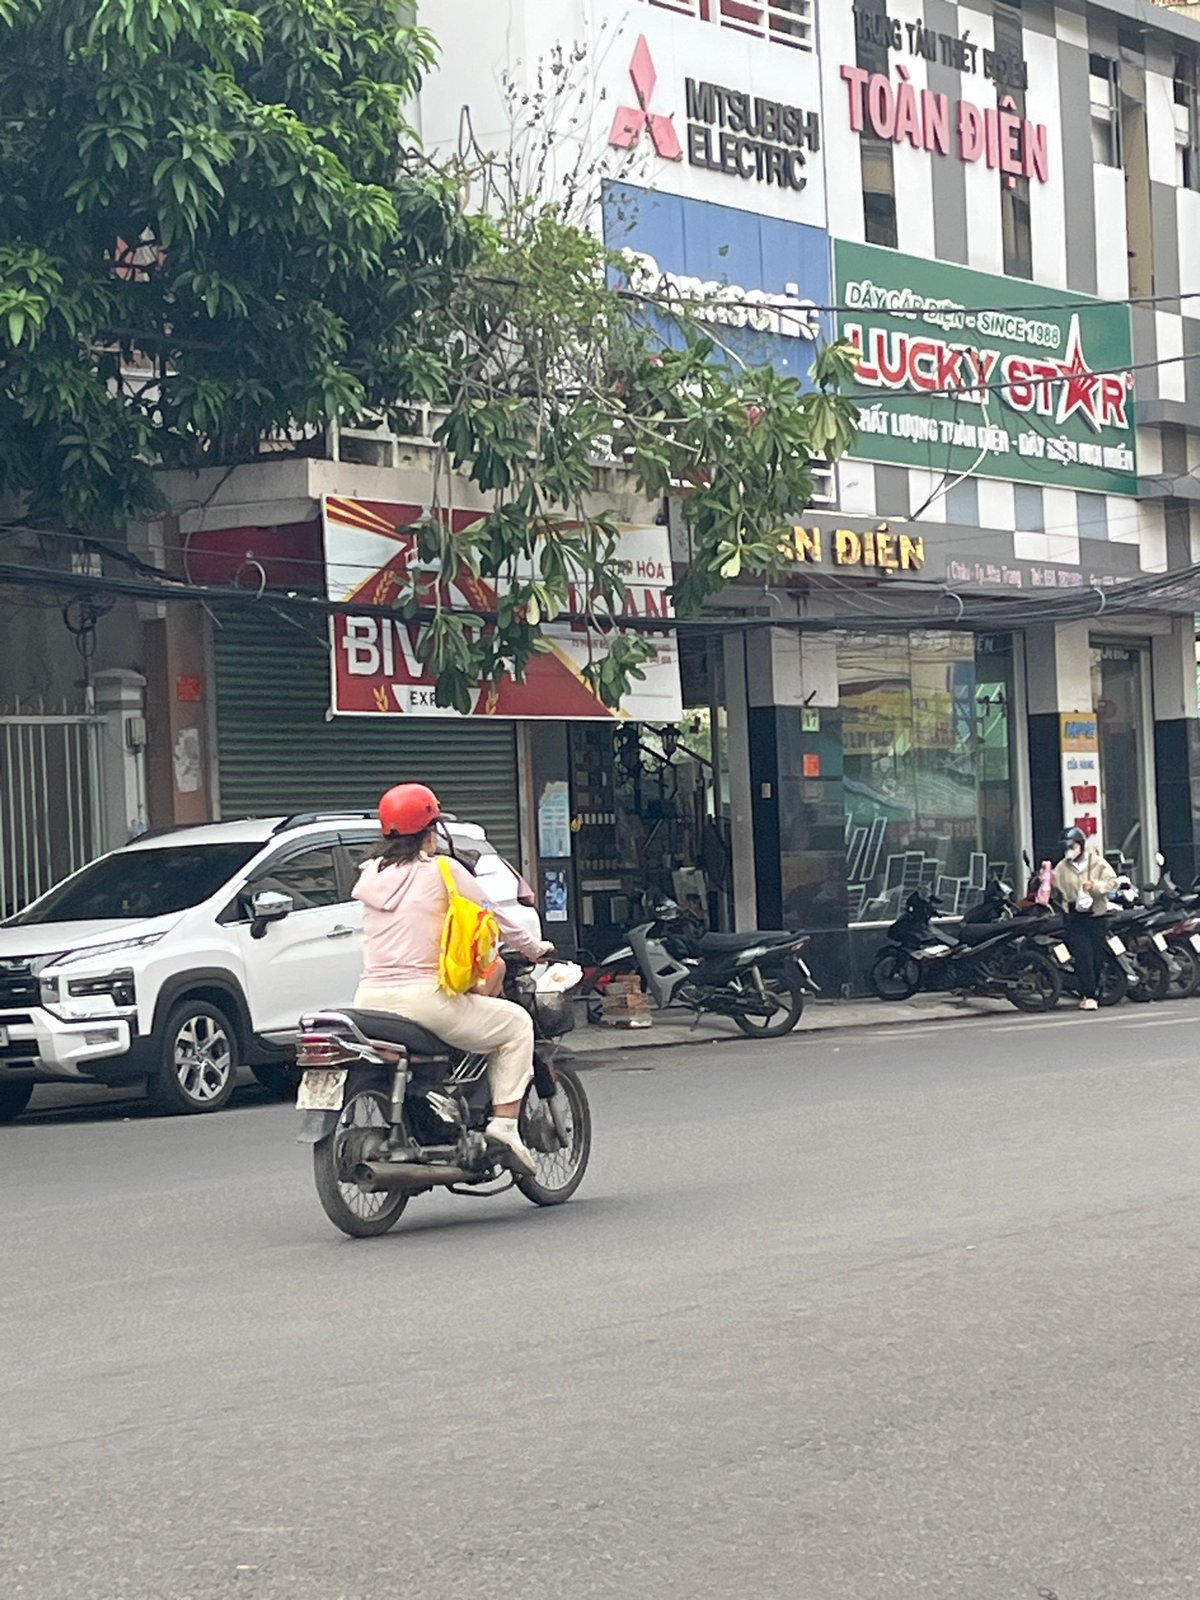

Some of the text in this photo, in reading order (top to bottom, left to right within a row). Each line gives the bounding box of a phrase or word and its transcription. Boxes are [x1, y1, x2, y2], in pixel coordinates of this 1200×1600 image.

[685, 77, 820, 152] MITSUBISHI
[839, 64, 1048, 190] TOÀN ĐIỆN
[687, 123, 807, 191] ELECTRIC
[845, 280, 887, 308] DÂY
[977, 311, 1027, 340] SINCE
[1026, 320, 1061, 349] 1988
[843, 323, 1001, 405] LUCKY
[636, 556, 666, 580] HÓA
